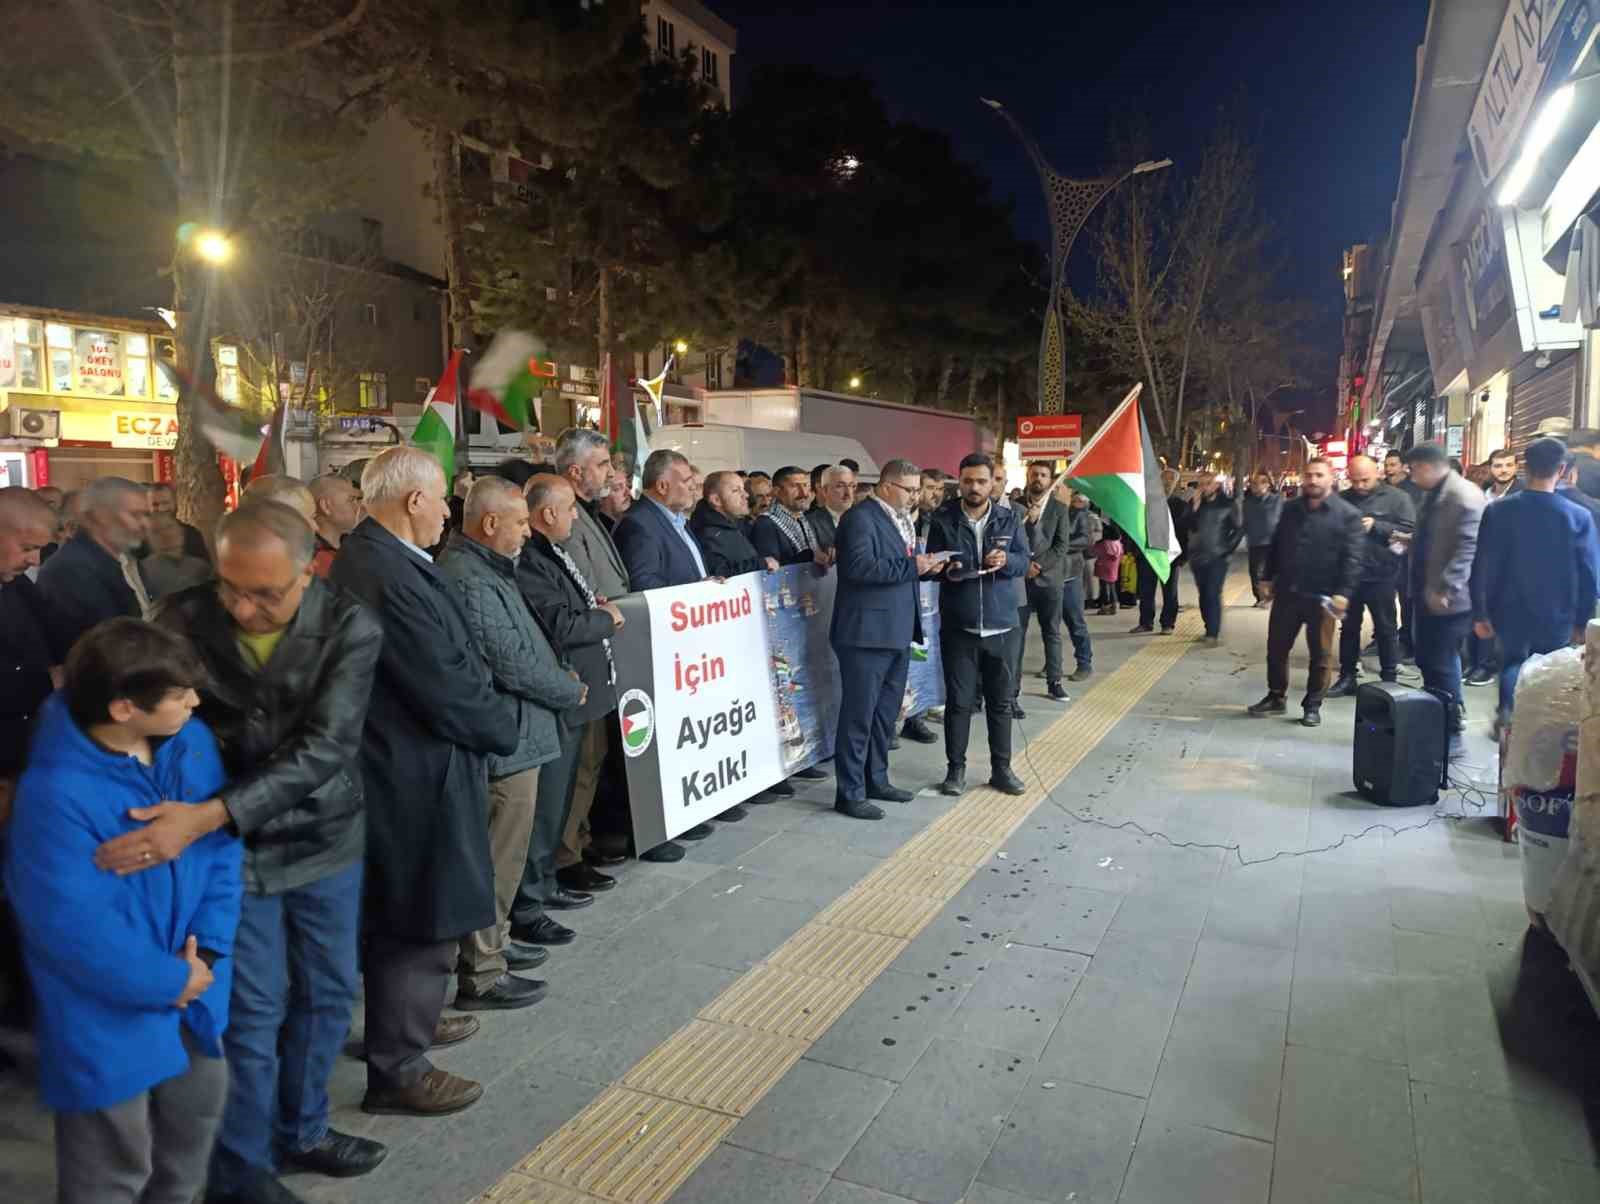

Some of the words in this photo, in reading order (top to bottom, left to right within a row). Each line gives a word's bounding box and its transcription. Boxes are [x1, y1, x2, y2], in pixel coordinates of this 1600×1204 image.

[79, 366, 122, 378] SALONU
[670, 588, 752, 632] Sumud
[673, 652, 726, 696] İçin
[676, 698, 757, 750] Ayağa
[681, 749, 748, 808] Kalk!
